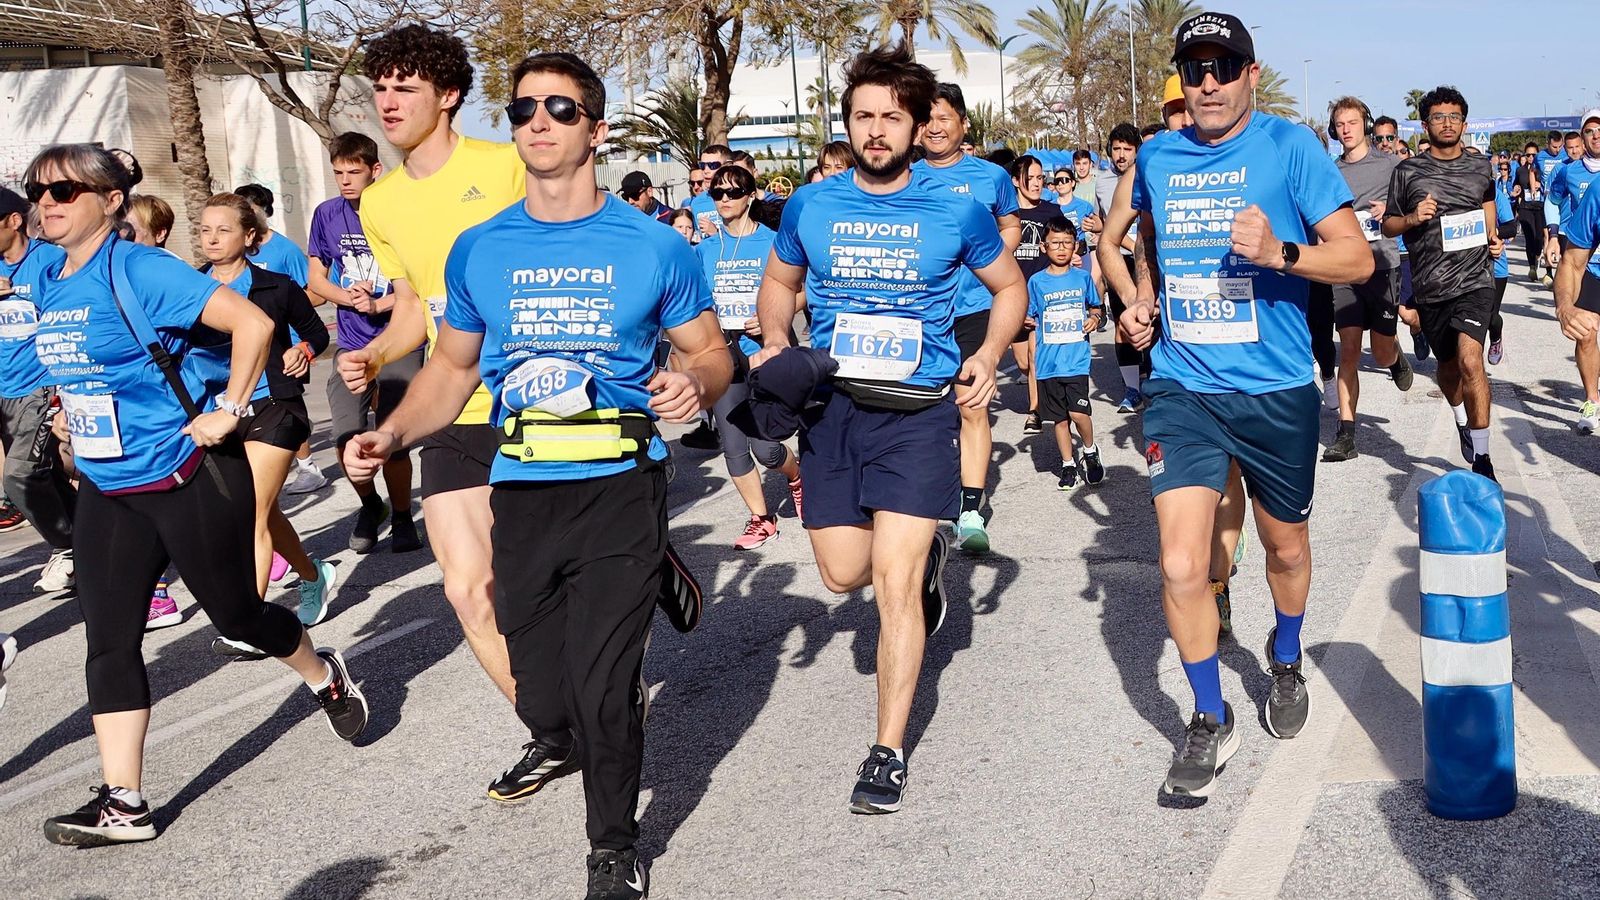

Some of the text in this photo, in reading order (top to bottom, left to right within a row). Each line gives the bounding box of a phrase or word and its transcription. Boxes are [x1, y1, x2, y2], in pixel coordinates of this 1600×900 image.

[1189, 15, 1227, 27] VENEZIA
[1169, 167, 1246, 190] mayoral
[461, 194, 486, 203] adidas
[1165, 197, 1242, 211] RUNNING
[1171, 209, 1235, 223] MAKES
[832, 221, 919, 240] mayoral
[1166, 221, 1231, 235] FRIENDS
[1452, 222, 1476, 238] 2727
[829, 245, 915, 259] RUNNING
[716, 258, 761, 269] mayoral
[838, 257, 908, 269] MAKES
[512, 265, 613, 287] mayoral
[831, 267, 904, 280] FRIENDS
[1225, 280, 1250, 288] mayoral
[1043, 288, 1083, 302] mayoral
[510, 296, 609, 310] RUNNING
[1181, 299, 1237, 320] 1389
[519, 310, 600, 323] MAKES
[719, 304, 751, 317] 2163
[511, 322, 596, 337] FRIENDS
[1050, 321, 1077, 333] 2275
[849, 334, 904, 358] 1675
[517, 369, 568, 405] 1498
